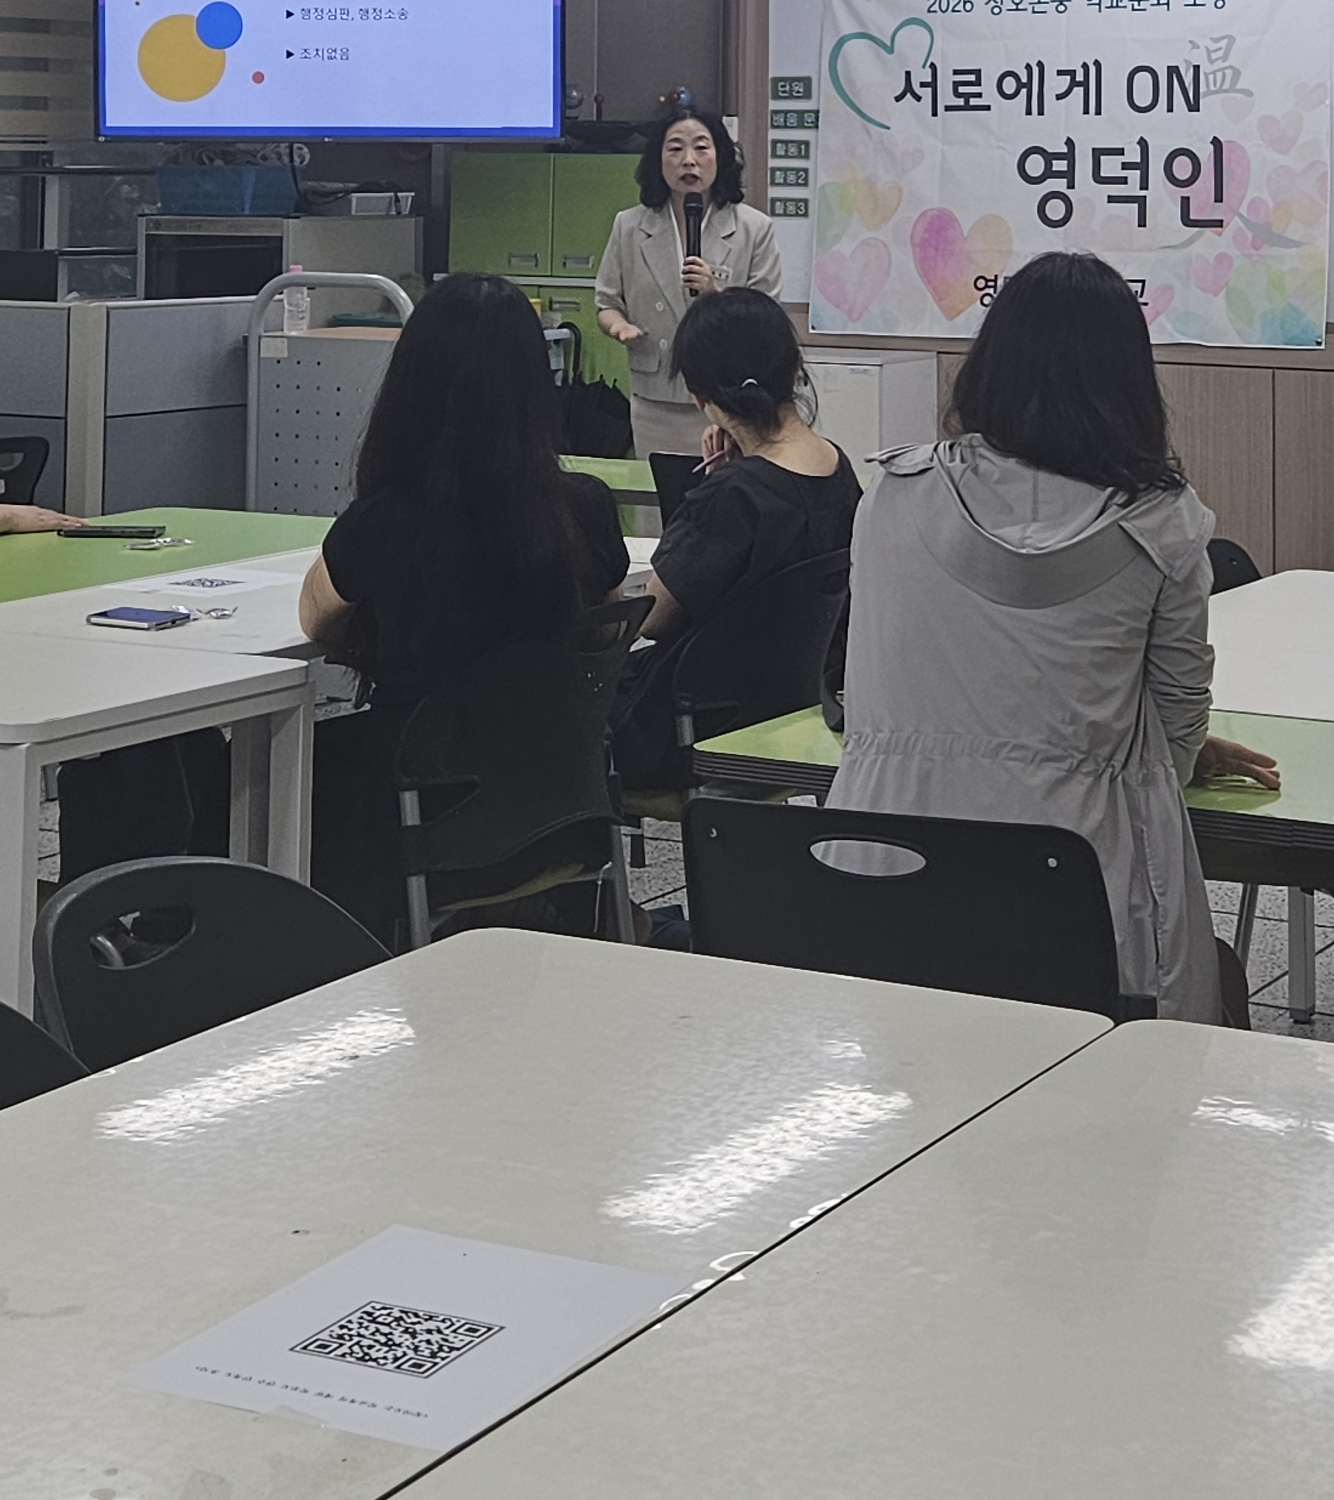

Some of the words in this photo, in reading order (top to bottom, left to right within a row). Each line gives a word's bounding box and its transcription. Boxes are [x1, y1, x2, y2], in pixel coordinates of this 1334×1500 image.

[300, 7, 355, 22] 행정심판,
[358, 7, 409, 21] 행정소송
[299, 47, 351, 62] 조치없음
[777, 81, 804, 97] 단원
[893, 58, 1103, 118] 서로에게
[1126, 63, 1202, 114] ON
[772, 112, 798, 127] 배움
[775, 143, 805, 156] 활동1
[774, 170, 806, 184] 활동2
[1016, 135, 1224, 229] 영덕인
[774, 201, 805, 215] 활동3
